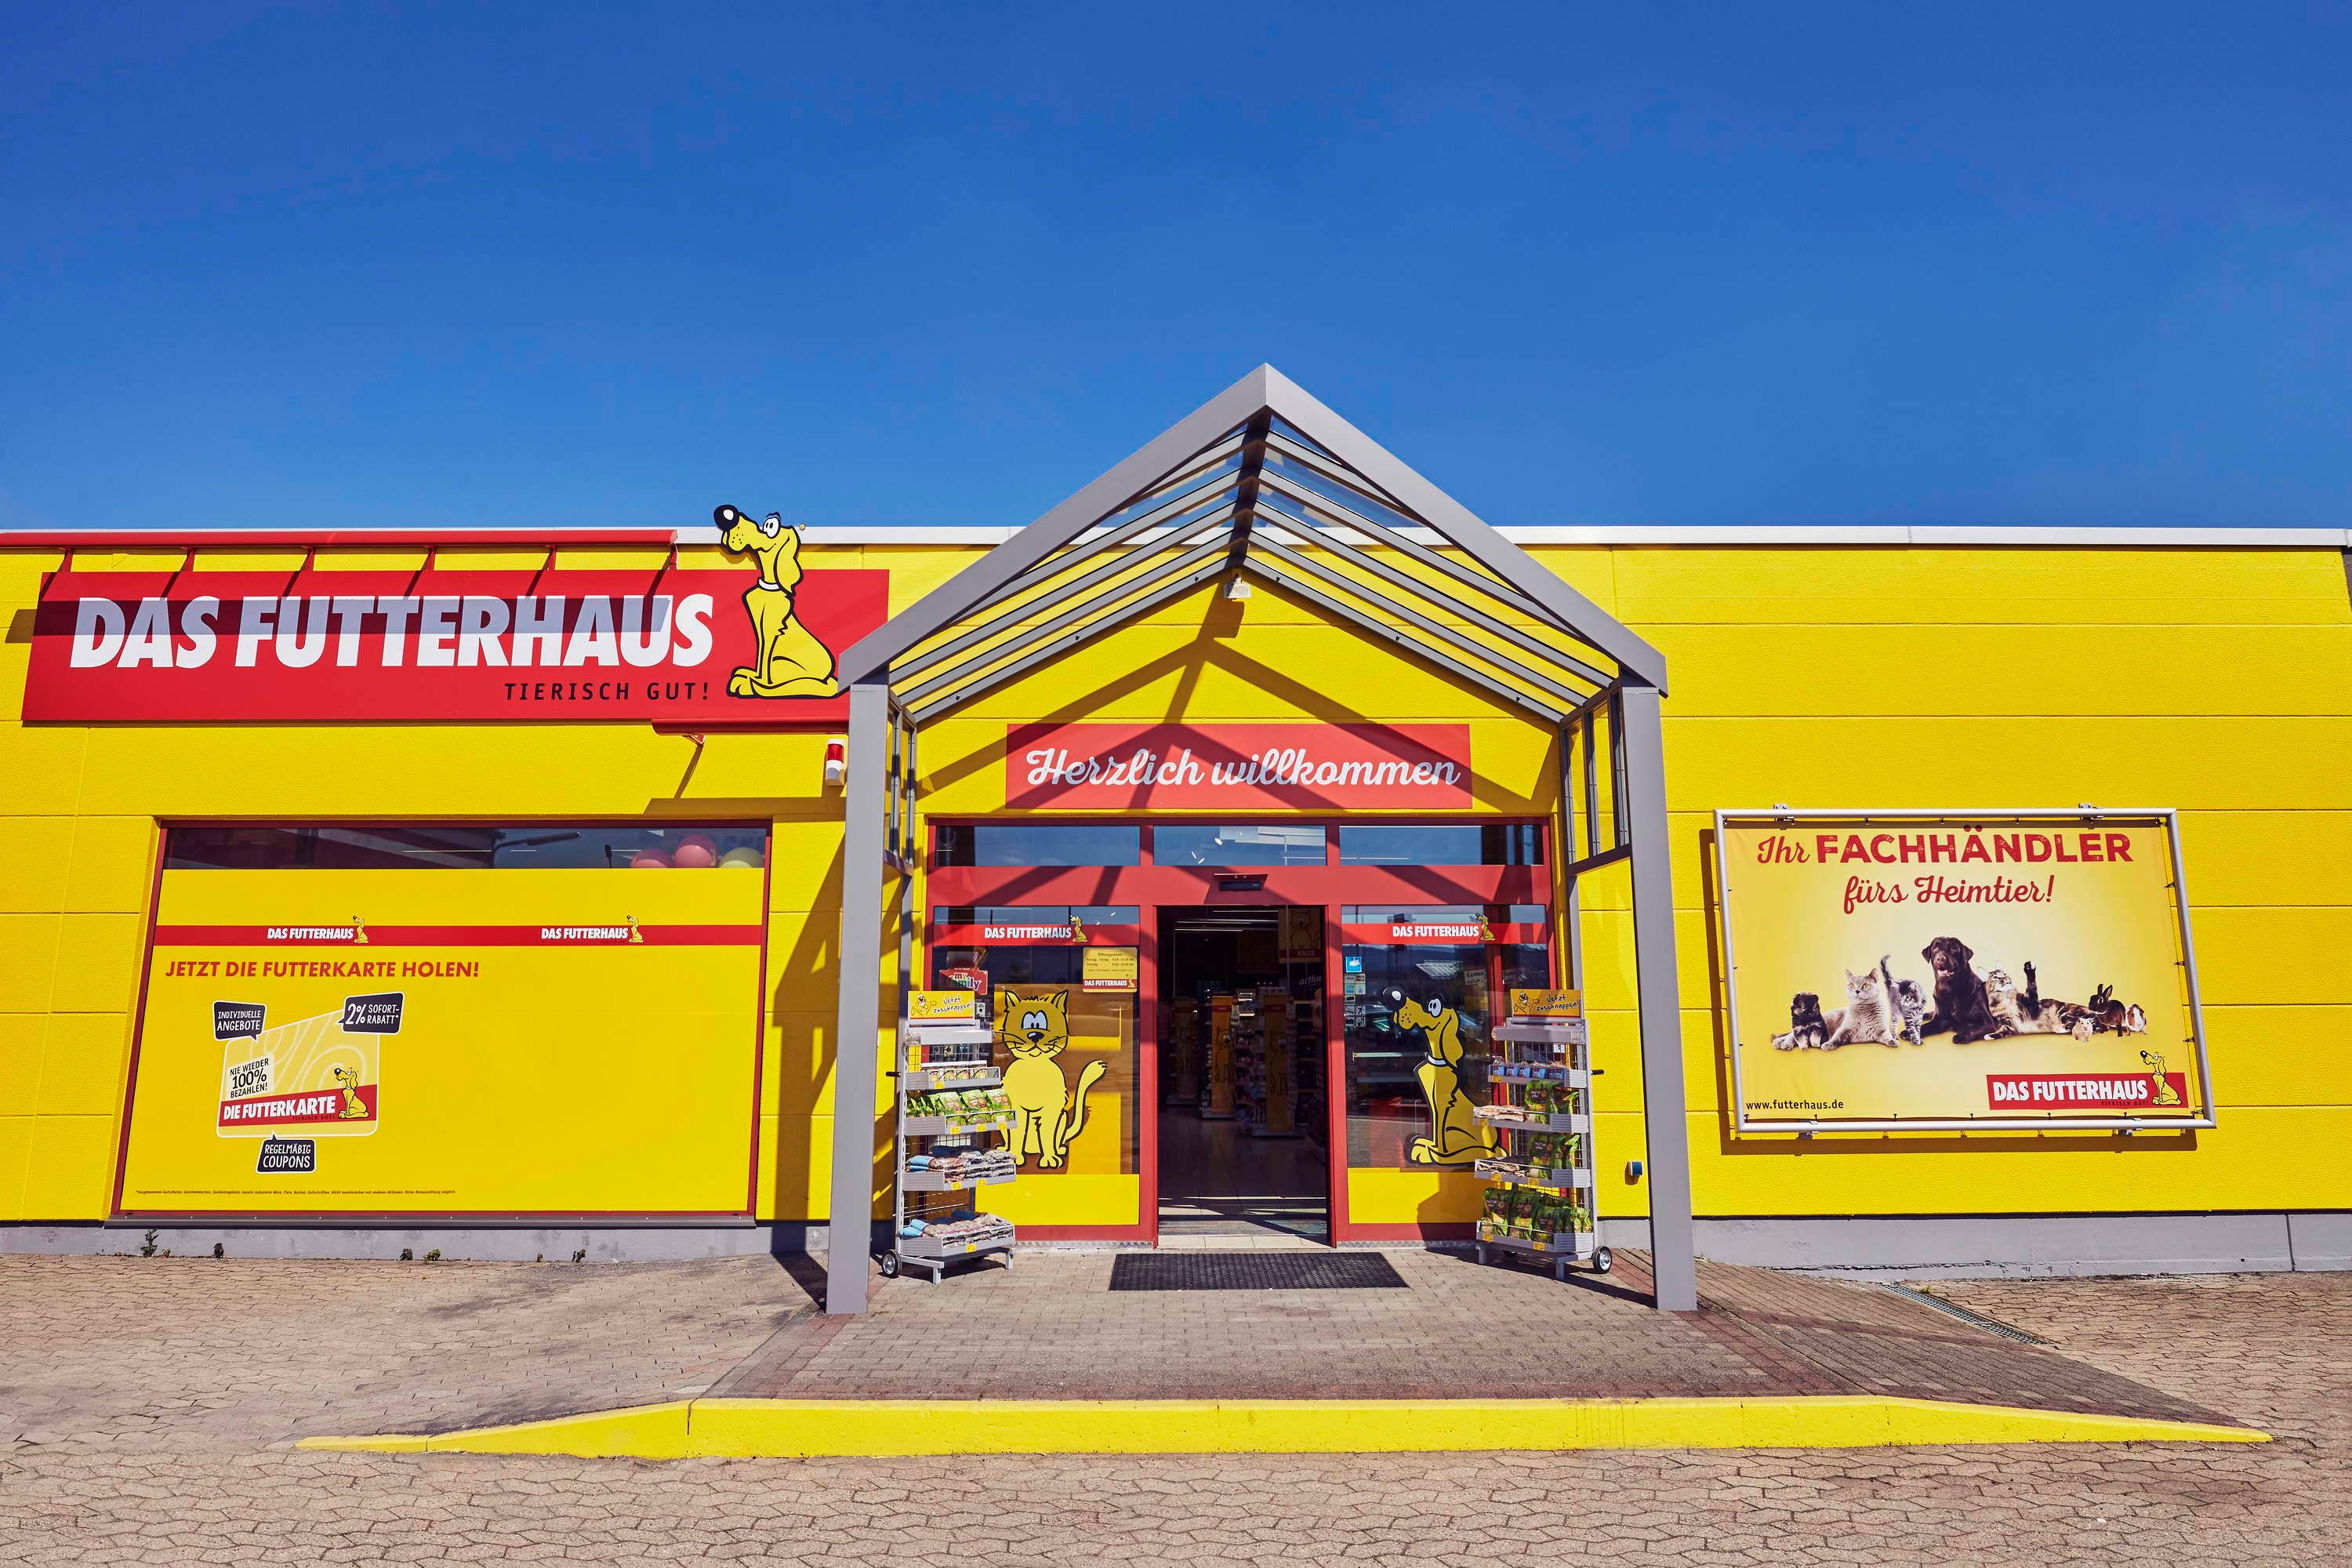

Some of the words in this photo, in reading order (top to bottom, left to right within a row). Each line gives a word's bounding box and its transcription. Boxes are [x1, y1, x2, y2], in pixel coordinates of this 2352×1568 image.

[69, 597, 219, 669] DAS
[234, 593, 714, 668] FUTTERHAUS
[504, 682, 630, 702] TIERISCH
[646, 681, 710, 701] GUT!
[1026, 748, 1205, 786] Herzlich
[1211, 748, 1461, 786] willkommen
[1757, 837, 1809, 864] Ihr
[1816, 825, 2133, 863] FACHHÄNDLER
[1844, 876, 1908, 915] fürs
[1914, 875, 2055, 903] Heimtier!
[267, 928, 289, 939] DAS
[289, 928, 354, 939] FUTTERHAUS
[541, 928, 562, 939] DAS
[564, 927, 628, 939] FUTTERHAUS
[985, 927, 1005, 938] DAS
[1007, 927, 1072, 938] FUTTERHAUS
[1392, 926, 1413, 937] DAS
[1414, 926, 1479, 937] FUTTERHAUS
[165, 961, 221, 978] JETZT
[225, 961, 257, 978] DIE
[263, 961, 396, 978] FUTTERKARTE
[401, 961, 479, 978] HOLEN!
[218, 1010, 261, 1019] INDIVIDUELLE
[345, 1004, 367, 1025] 2%
[368, 1004, 400, 1014] SOFORT-
[216, 1020, 261, 1031] ANGEBOTE
[230, 1066, 241, 1076] NIE
[242, 1058, 269, 1073] WIEDER
[232, 1068, 267, 1090] 100%
[230, 1083, 268, 1098] BEZAHLEN!
[1993, 1081, 2030, 1101] DAS
[2032, 1080, 2148, 1101] FUTTERHAUS
[223, 1105, 241, 1120] DIE
[242, 1095, 336, 1118] FUTTERKARTE
[1746, 1099, 1844, 1109] www.futterhaus.de
[263, 1156, 310, 1168] COUPONS
